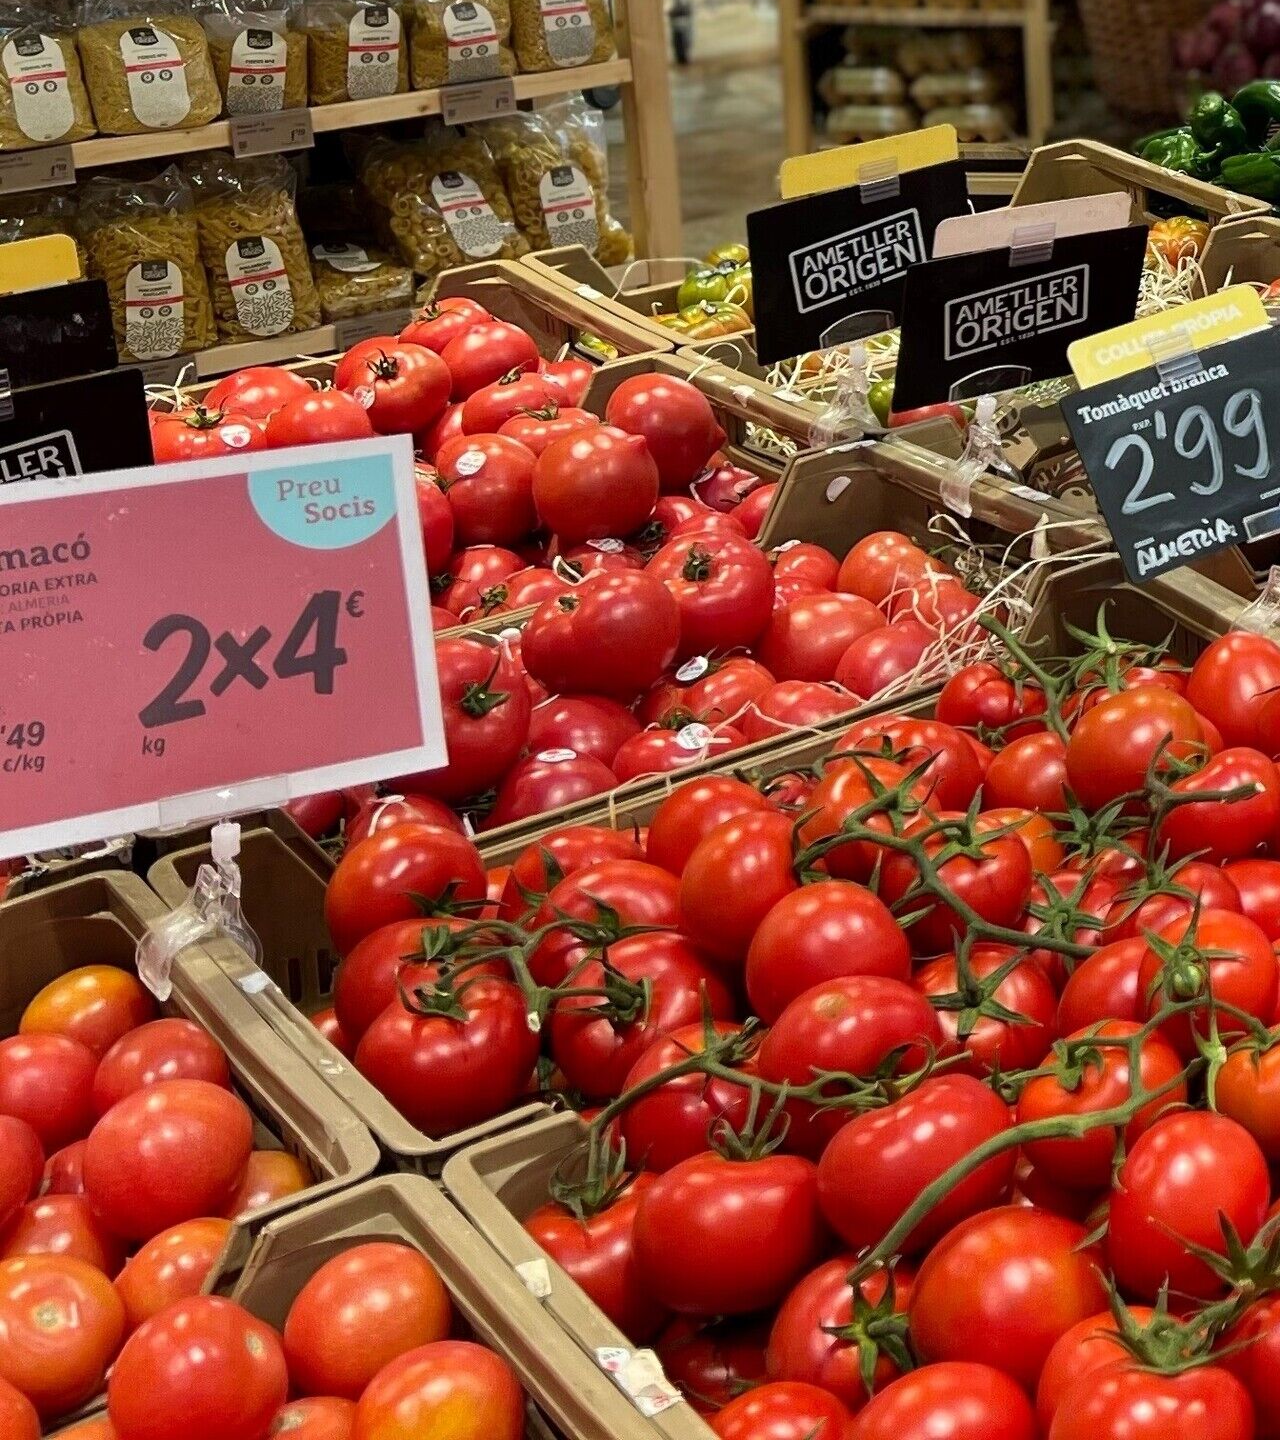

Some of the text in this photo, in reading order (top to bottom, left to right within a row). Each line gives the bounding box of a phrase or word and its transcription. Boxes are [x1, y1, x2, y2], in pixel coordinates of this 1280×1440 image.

[800, 219, 913, 277] AMETLLER
[804, 238, 917, 301] ORIGEN
[955, 274, 1080, 326] AMETLLER
[1076, 381, 1171, 426] Tomàquet
[1104, 387, 1271, 516] 2'99
[276, 477, 342, 502] Preu
[303, 495, 376, 525] Socis
[44, 571, 98, 592] EXTRA
[8, 593, 70, 612] ALMERIA
[21, 609, 84, 630] PRÒPIA
[142, 735, 166, 757] kg
